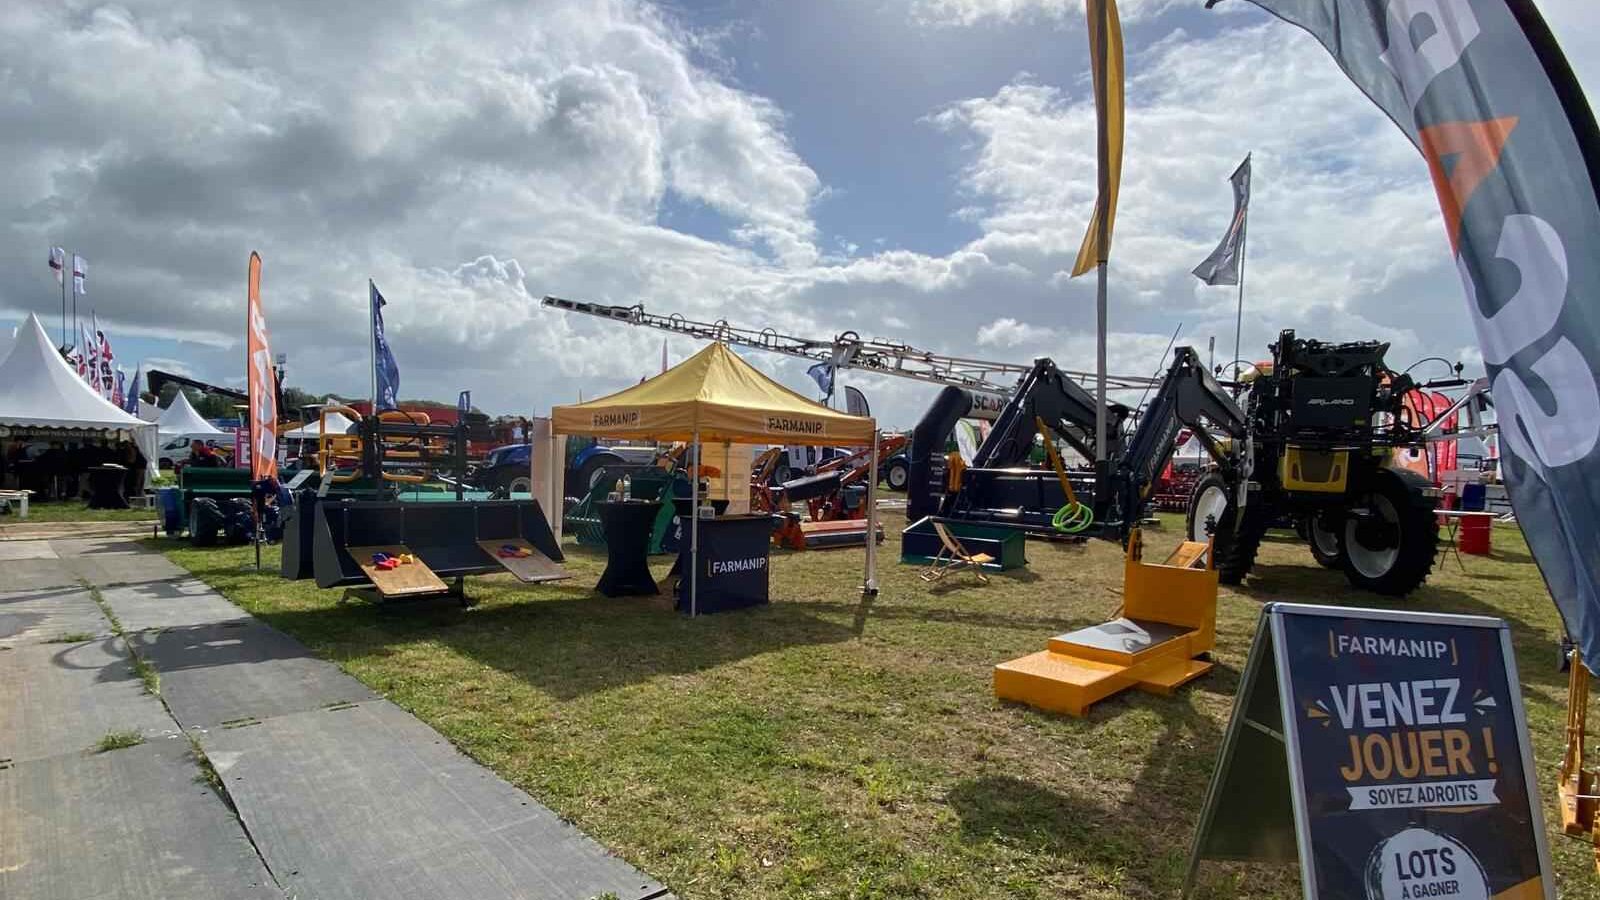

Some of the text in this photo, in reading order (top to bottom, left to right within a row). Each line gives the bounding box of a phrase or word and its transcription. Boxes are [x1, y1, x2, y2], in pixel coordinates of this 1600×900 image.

[594, 411, 638, 427] FARMANIP
[768, 417, 823, 434] FARMANIP
[712, 556, 766, 574] FARMANIP
[1337, 635, 1448, 659] FARMANIP
[1328, 677, 1466, 729] VENEZ
[1340, 728, 1476, 782] JOUER
[1368, 784, 1479, 806] SOYEZ ADROITS
[1395, 846, 1457, 881] LOTS
[1401, 880, 1461, 900] À GAGNER
